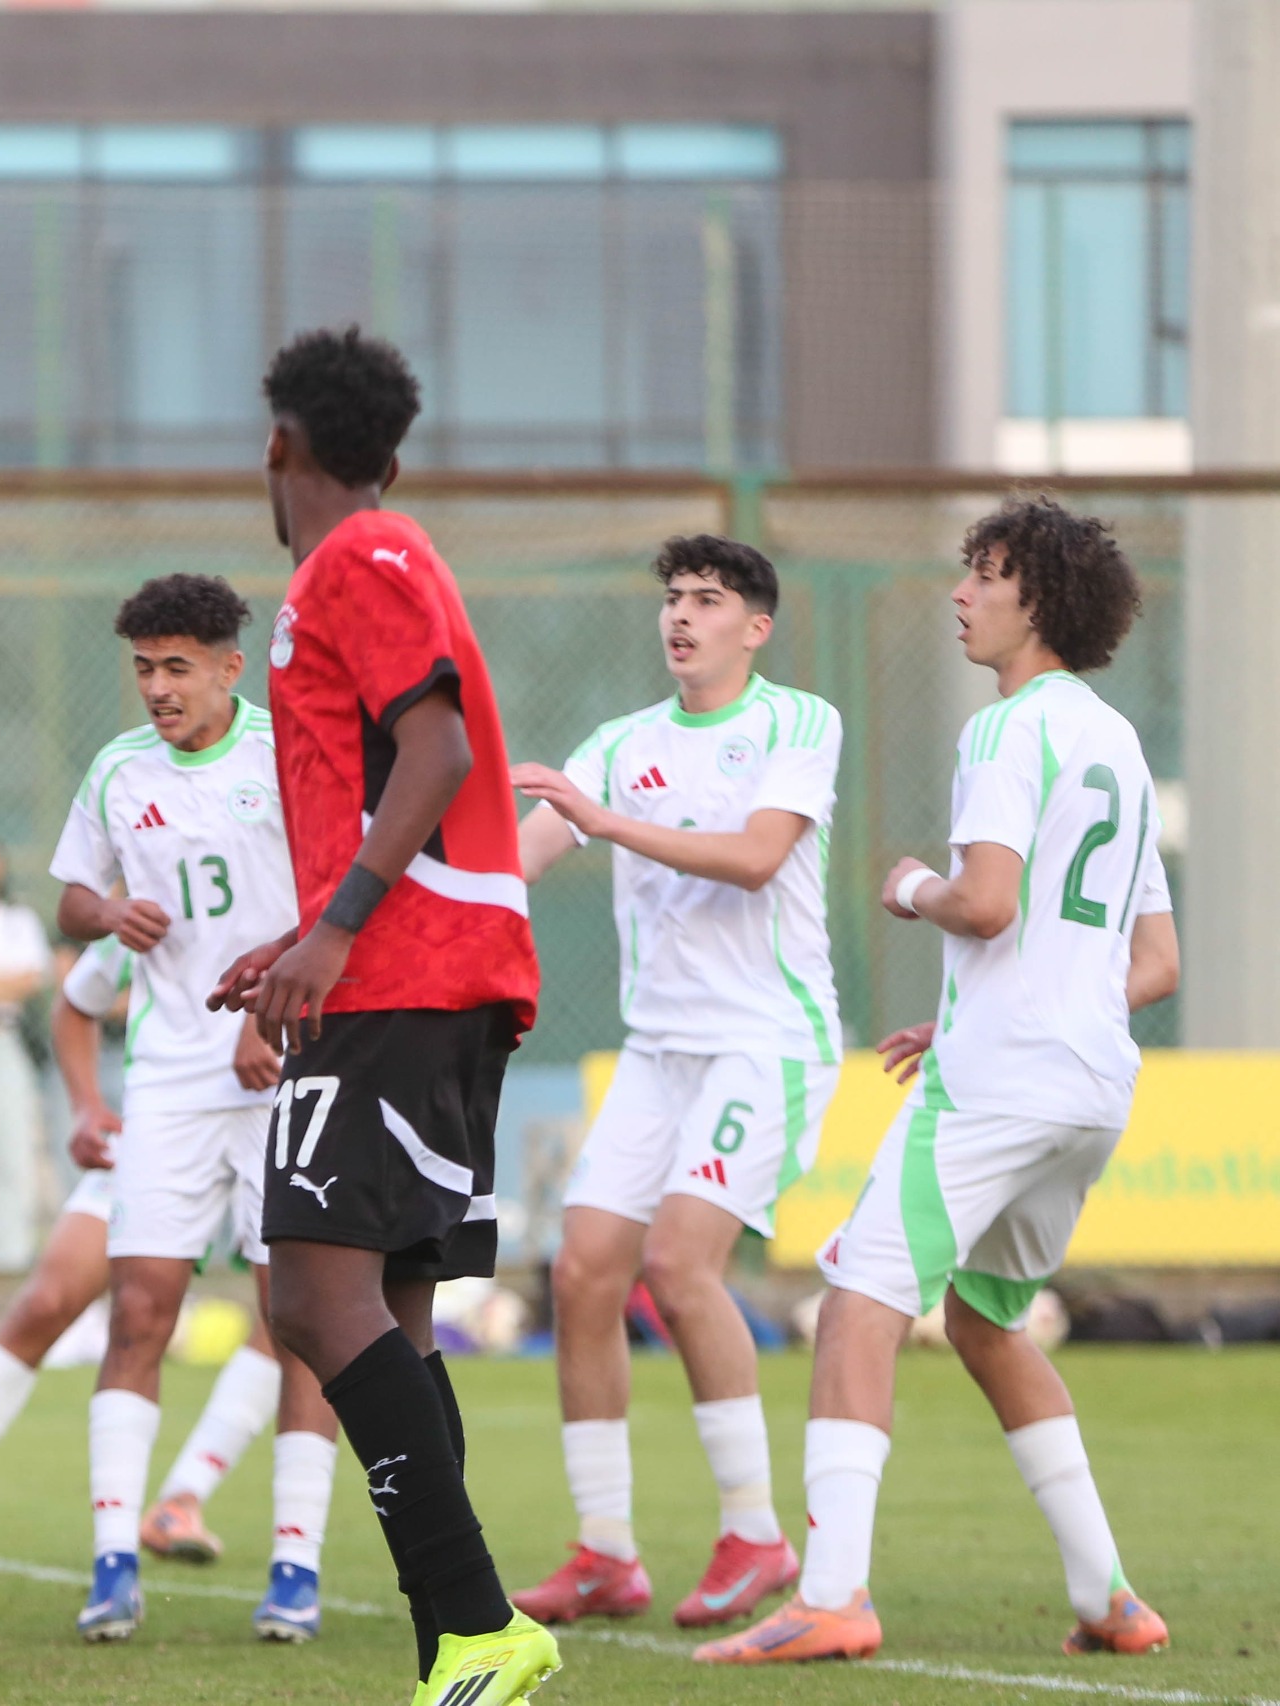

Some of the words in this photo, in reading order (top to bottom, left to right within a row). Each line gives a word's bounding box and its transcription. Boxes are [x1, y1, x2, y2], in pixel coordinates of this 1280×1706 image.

[1061, 763, 1149, 935] 21
[178, 855, 233, 919] 13
[273, 1076, 340, 1170] 17
[711, 1101, 754, 1154] 6
[455, 1650, 514, 1679] F50
